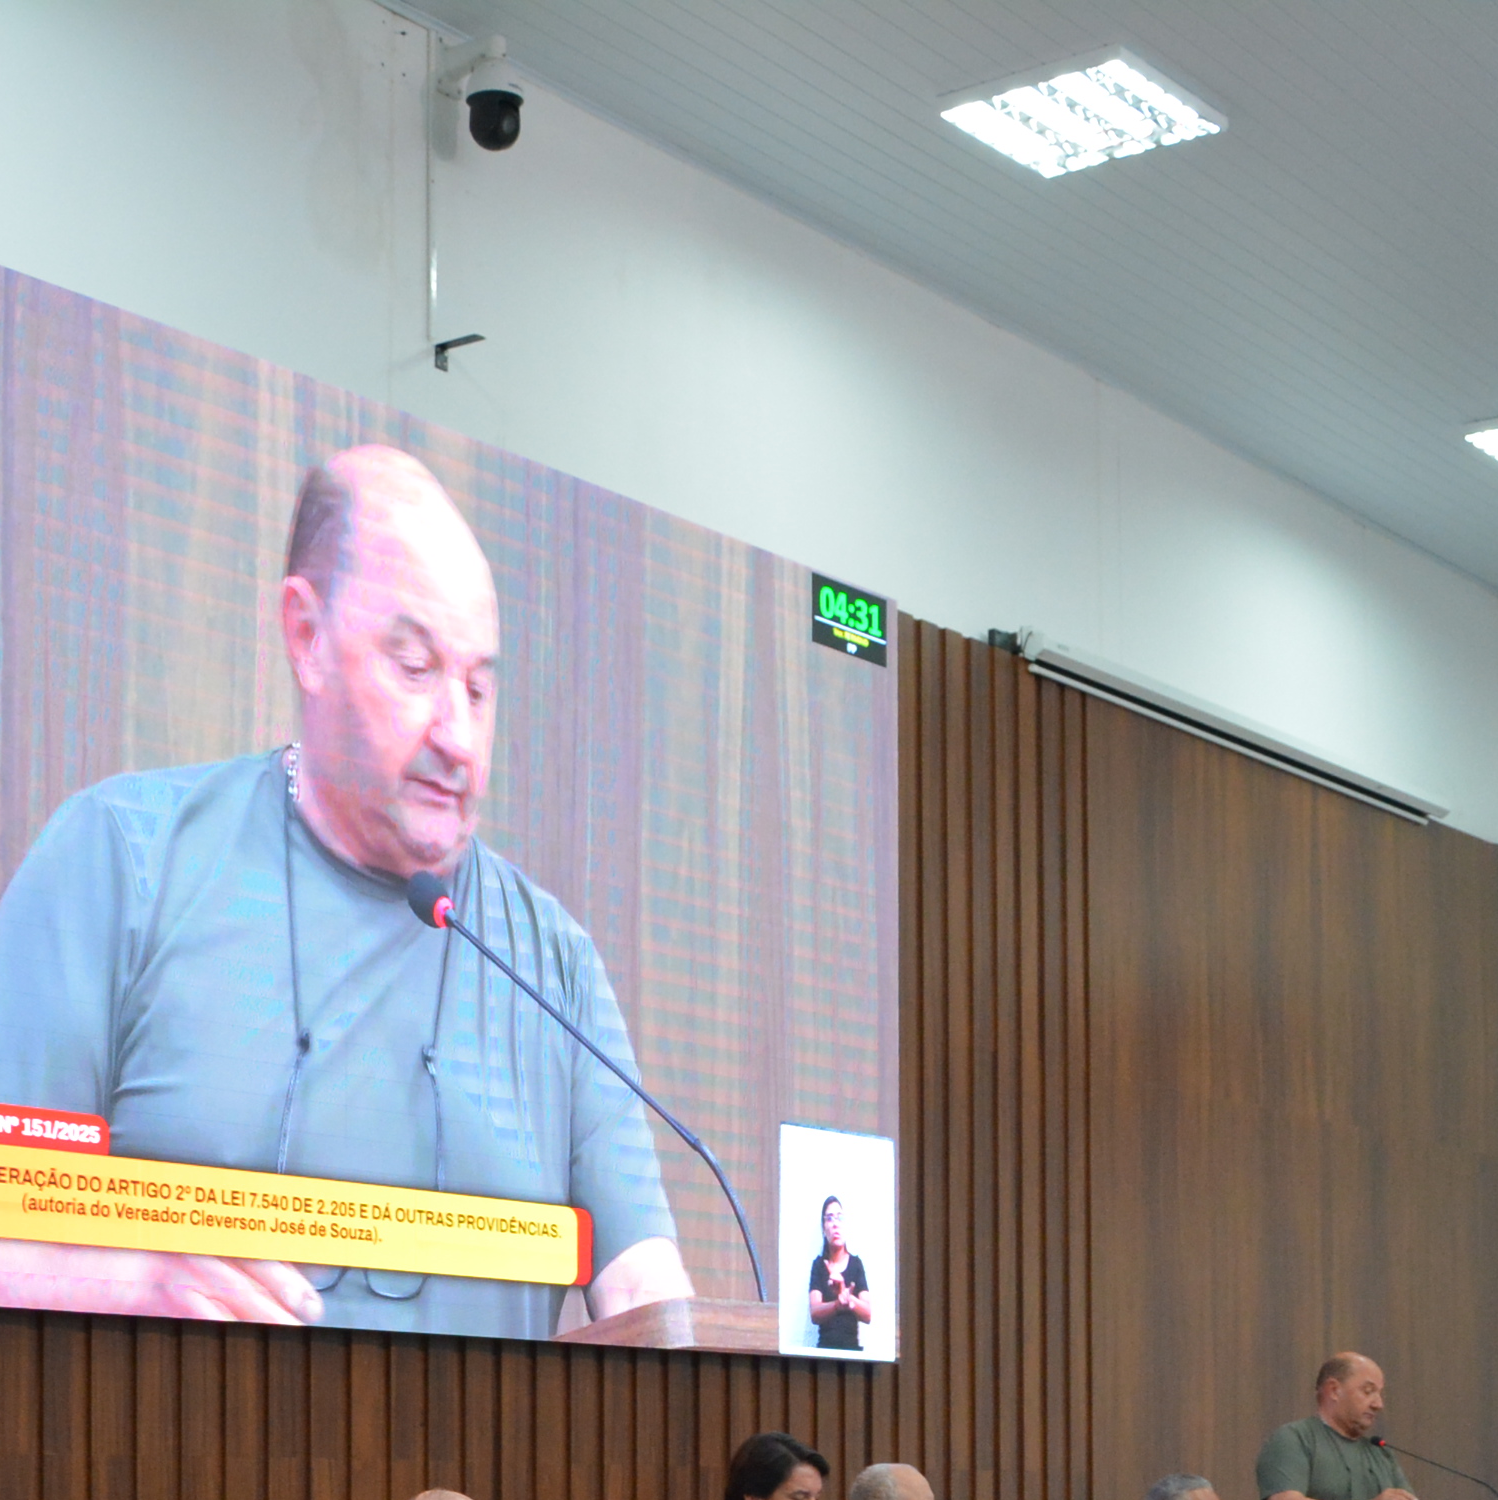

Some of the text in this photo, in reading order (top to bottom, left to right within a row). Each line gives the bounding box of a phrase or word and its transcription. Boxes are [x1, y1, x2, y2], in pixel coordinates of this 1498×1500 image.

[820, 585, 883, 638] 04:31
[21, 1117, 101, 1144] 151/2025
[22, 1193, 383, 1245] (autoria do Vereador Cleverson José de Souza).
[77, 1175, 102, 1193] DO
[106, 1178, 171, 1200] ARTIGO
[195, 1187, 217, 1204] DA
[221, 1190, 246, 1207] LEI
[249, 1192, 288, 1212] 7.540
[292, 1196, 313, 1214] DE
[317, 1199, 356, 1218] 2.205
[359, 1203, 369, 1219] E
[372, 1202, 392, 1221] DÁ
[395, 1206, 454, 1228] OUTRAS
[457, 1213, 562, 1239] PROVIDÊNCIAS.
